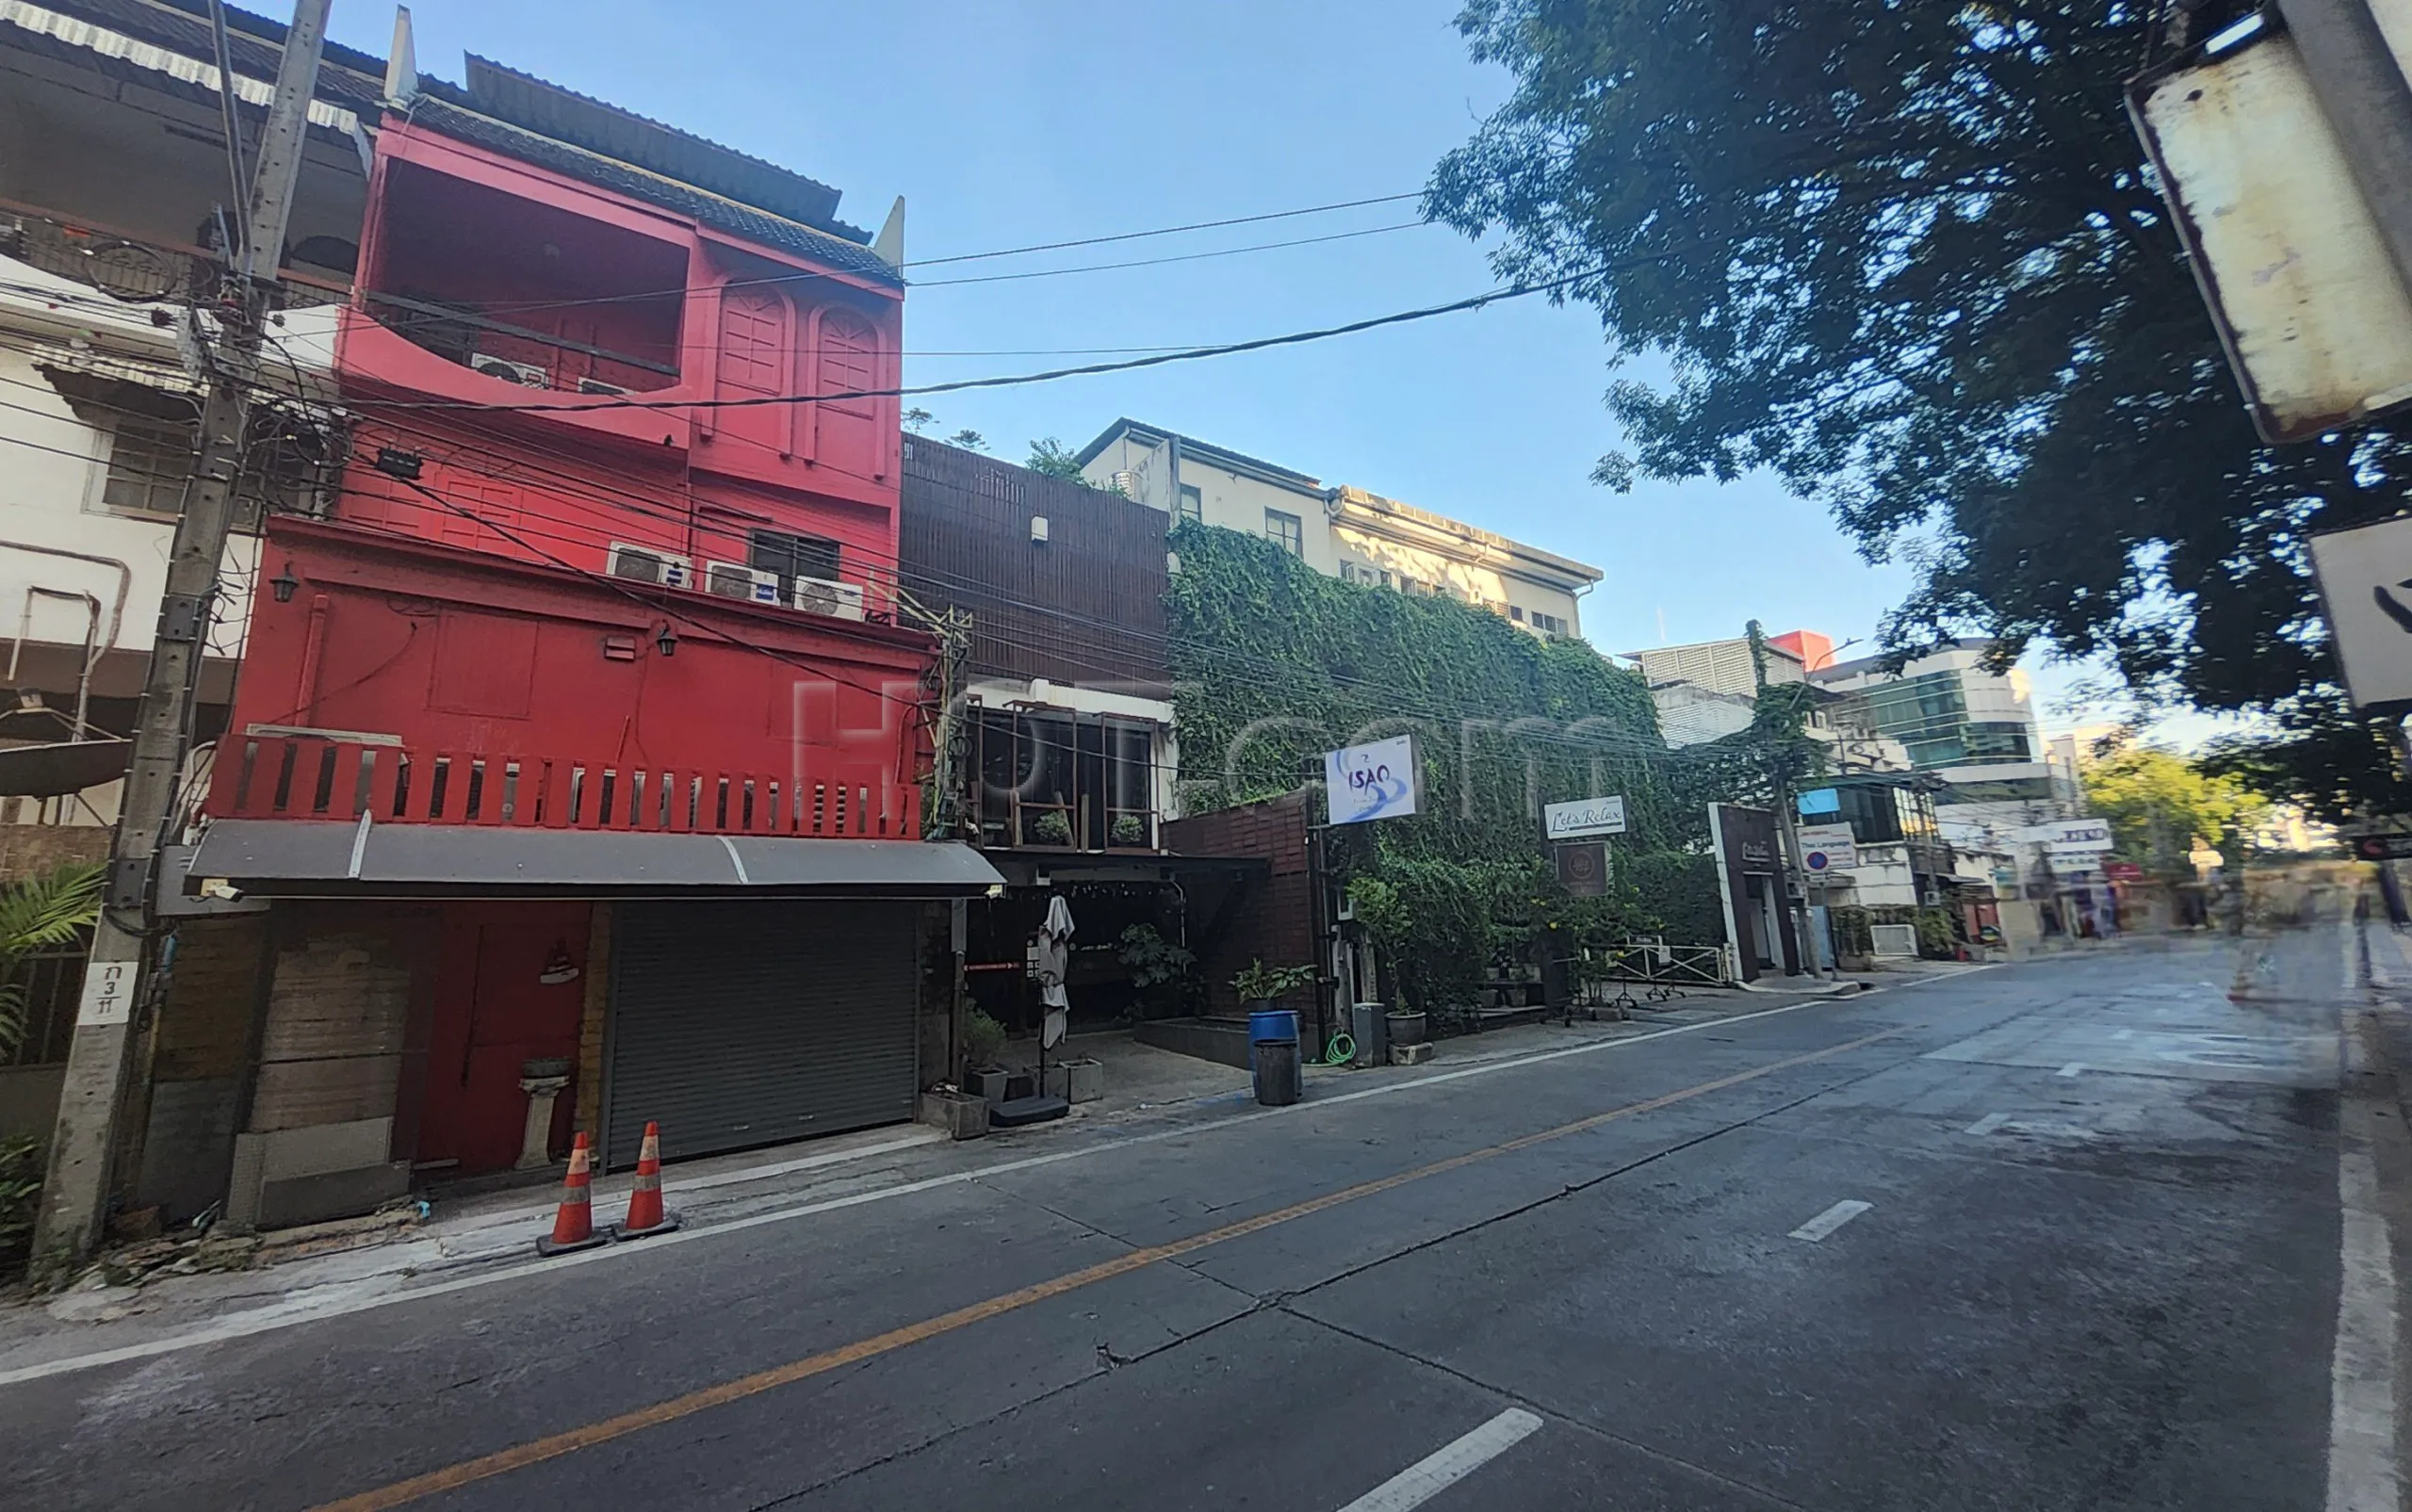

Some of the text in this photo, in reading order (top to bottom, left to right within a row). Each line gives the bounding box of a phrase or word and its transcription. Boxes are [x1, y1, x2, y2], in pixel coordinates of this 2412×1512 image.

[1348, 765, 1390, 796] ISAO
[1551, 807, 1621, 833] Let's Relax
[104, 982, 116, 995] 3
[98, 1000, 112, 1015] 11
